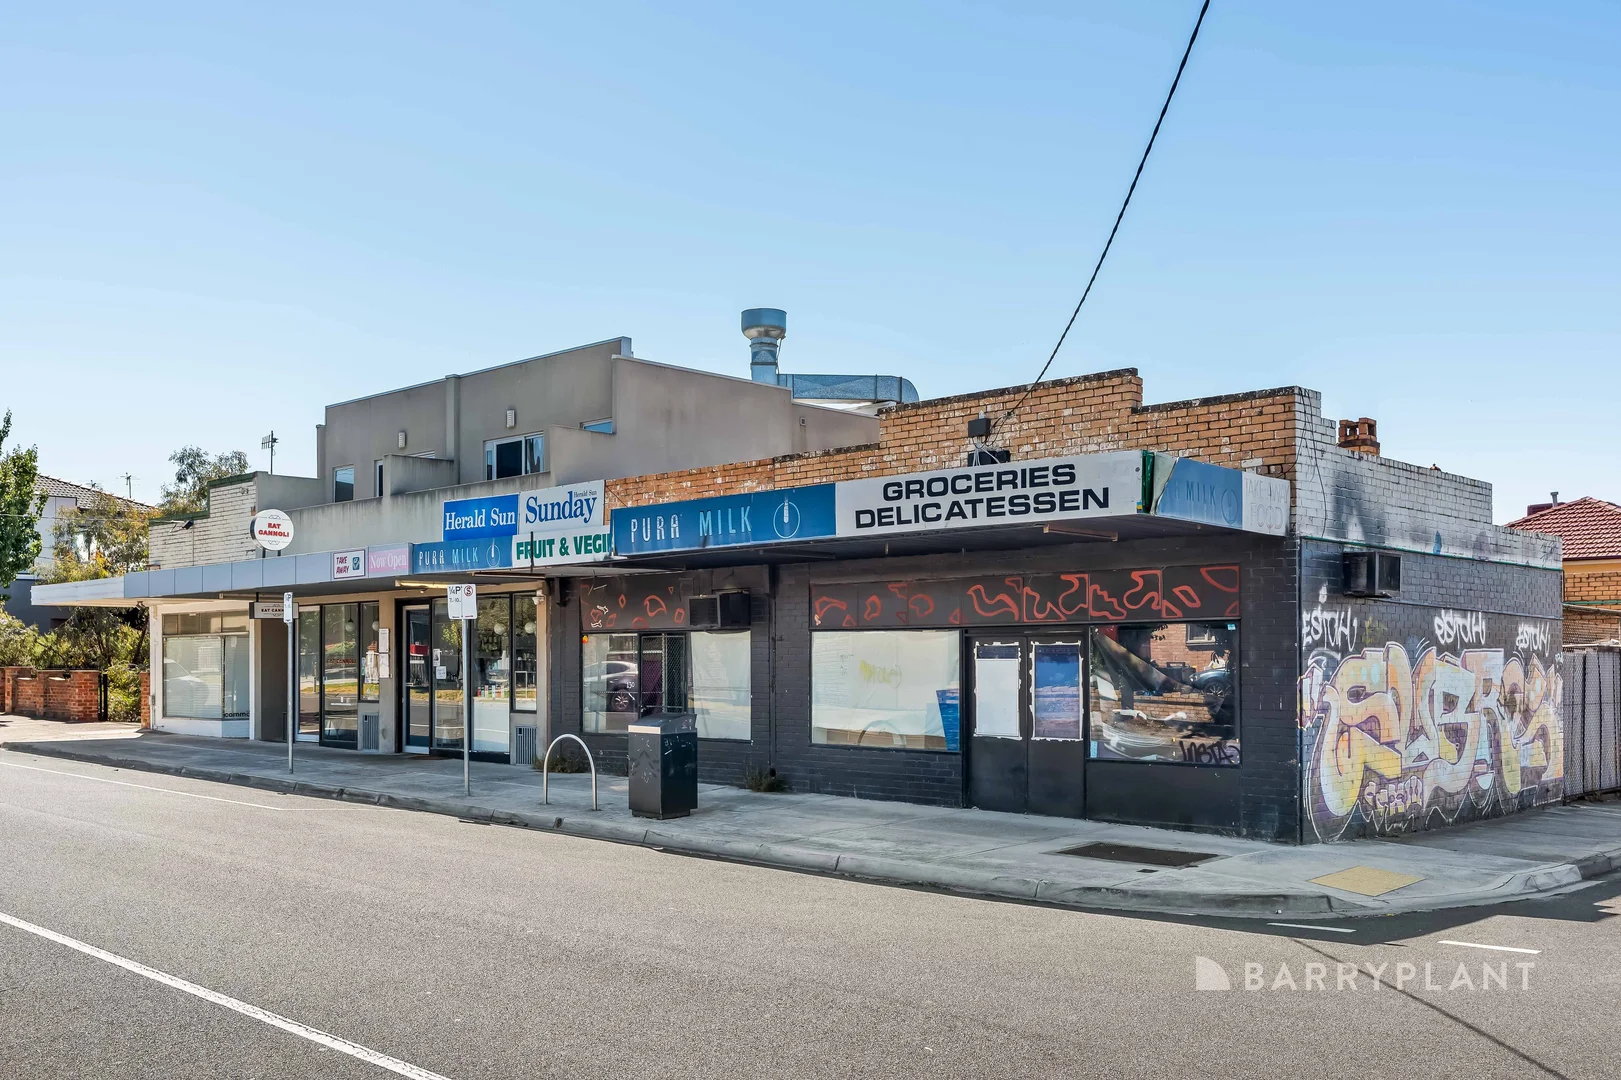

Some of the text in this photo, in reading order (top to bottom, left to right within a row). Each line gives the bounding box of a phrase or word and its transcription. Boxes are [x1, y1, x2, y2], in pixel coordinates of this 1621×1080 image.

[882, 463, 1077, 502] GROCERIES
[1186, 480, 1216, 506] MILK
[574, 490, 588, 498] Herald
[525, 490, 597, 524] Sunday
[854, 487, 1110, 529] DELICATESSEN
[267, 522, 281, 530] EAT
[444, 507, 516, 531] Herald Sun
[631, 505, 752, 543] PURA MILK
[258, 529, 290, 538] CANNOLI
[418, 547, 479, 566] PURA MILK
[516, 537, 555, 560] FRUIT
[559, 537, 570, 556] &
[335, 566, 350, 575] AWAY
[336, 556, 348, 565] TAKE
[370, 552, 407, 570] Now Open
